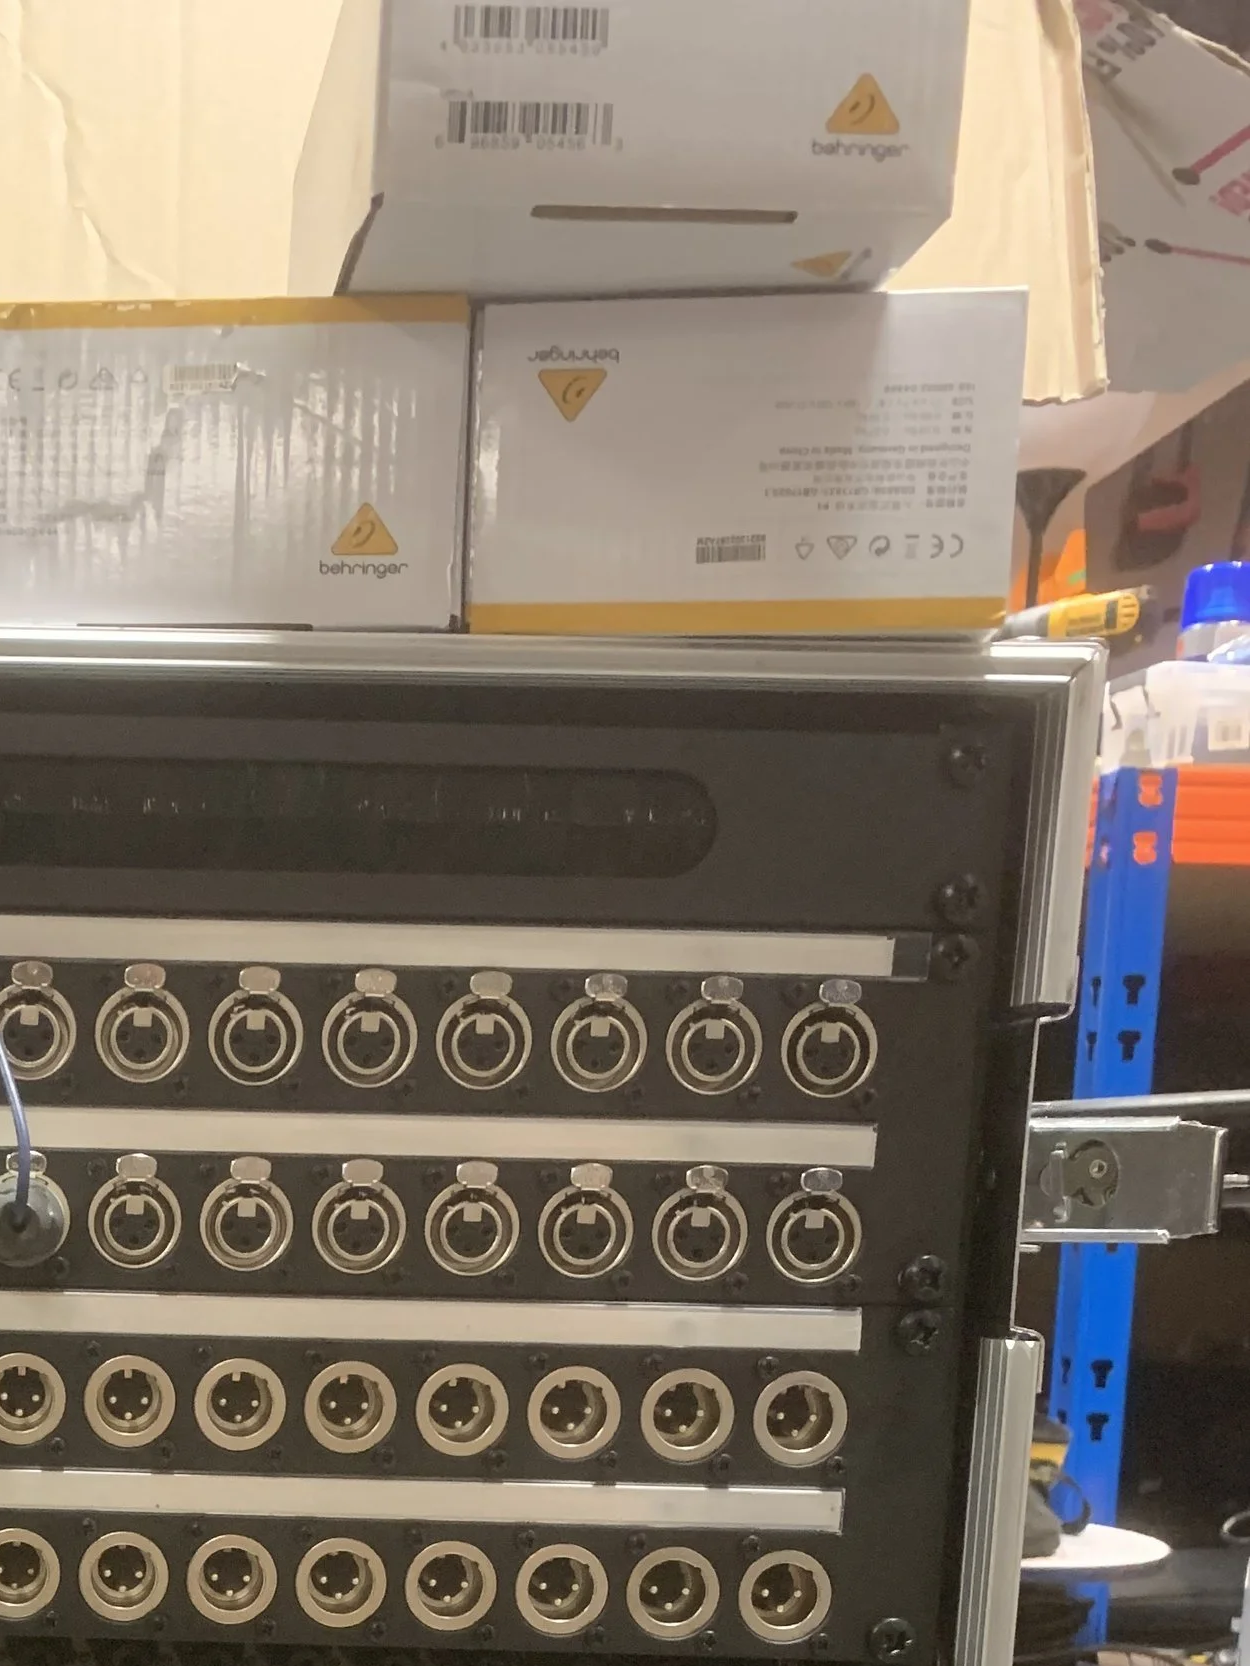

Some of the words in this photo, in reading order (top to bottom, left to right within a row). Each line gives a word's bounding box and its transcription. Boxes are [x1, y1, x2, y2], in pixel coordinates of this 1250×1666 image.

[811, 138, 910, 162] behringer
[527, 345, 621, 364] behringer
[319, 560, 408, 579] behringer
